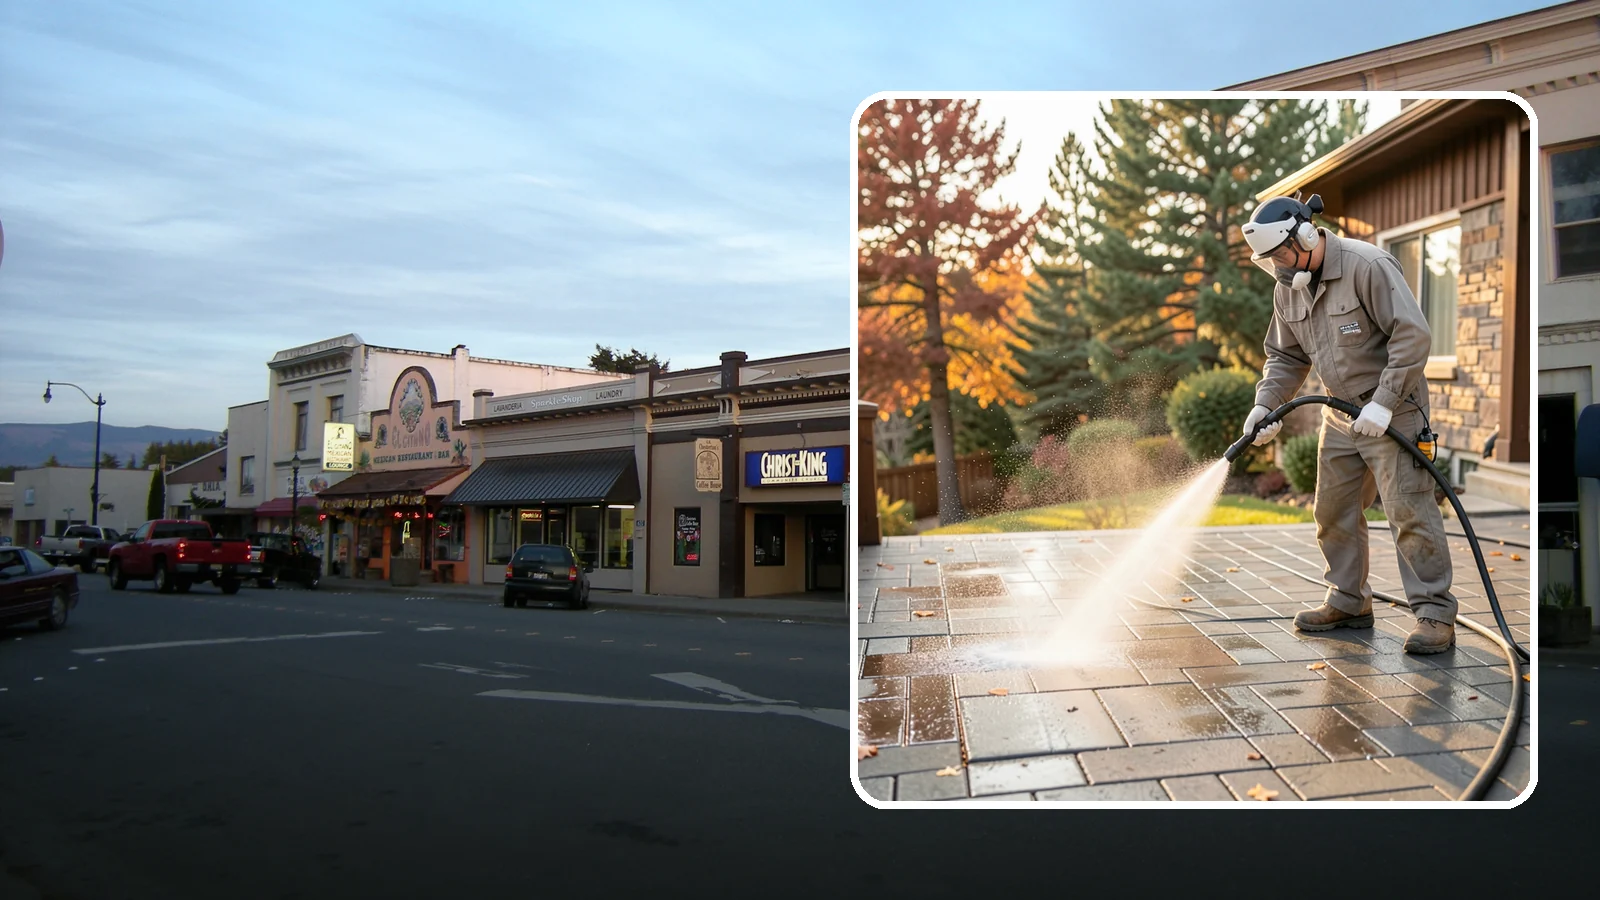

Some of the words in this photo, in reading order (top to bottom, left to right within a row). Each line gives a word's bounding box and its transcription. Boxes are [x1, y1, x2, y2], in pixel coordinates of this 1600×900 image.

[562, 394, 582, 404] Shop
[596, 389, 622, 400] LAUNDRY
[493, 402, 522, 412] LAVANDERIA
[374, 456, 396, 464] MEXICAN
[398, 452, 433, 462] RESTAURANT
[438, 450, 450, 458] BAR
[761, 452, 797, 478] CHRIST
[798, 450, 828, 476] KING
